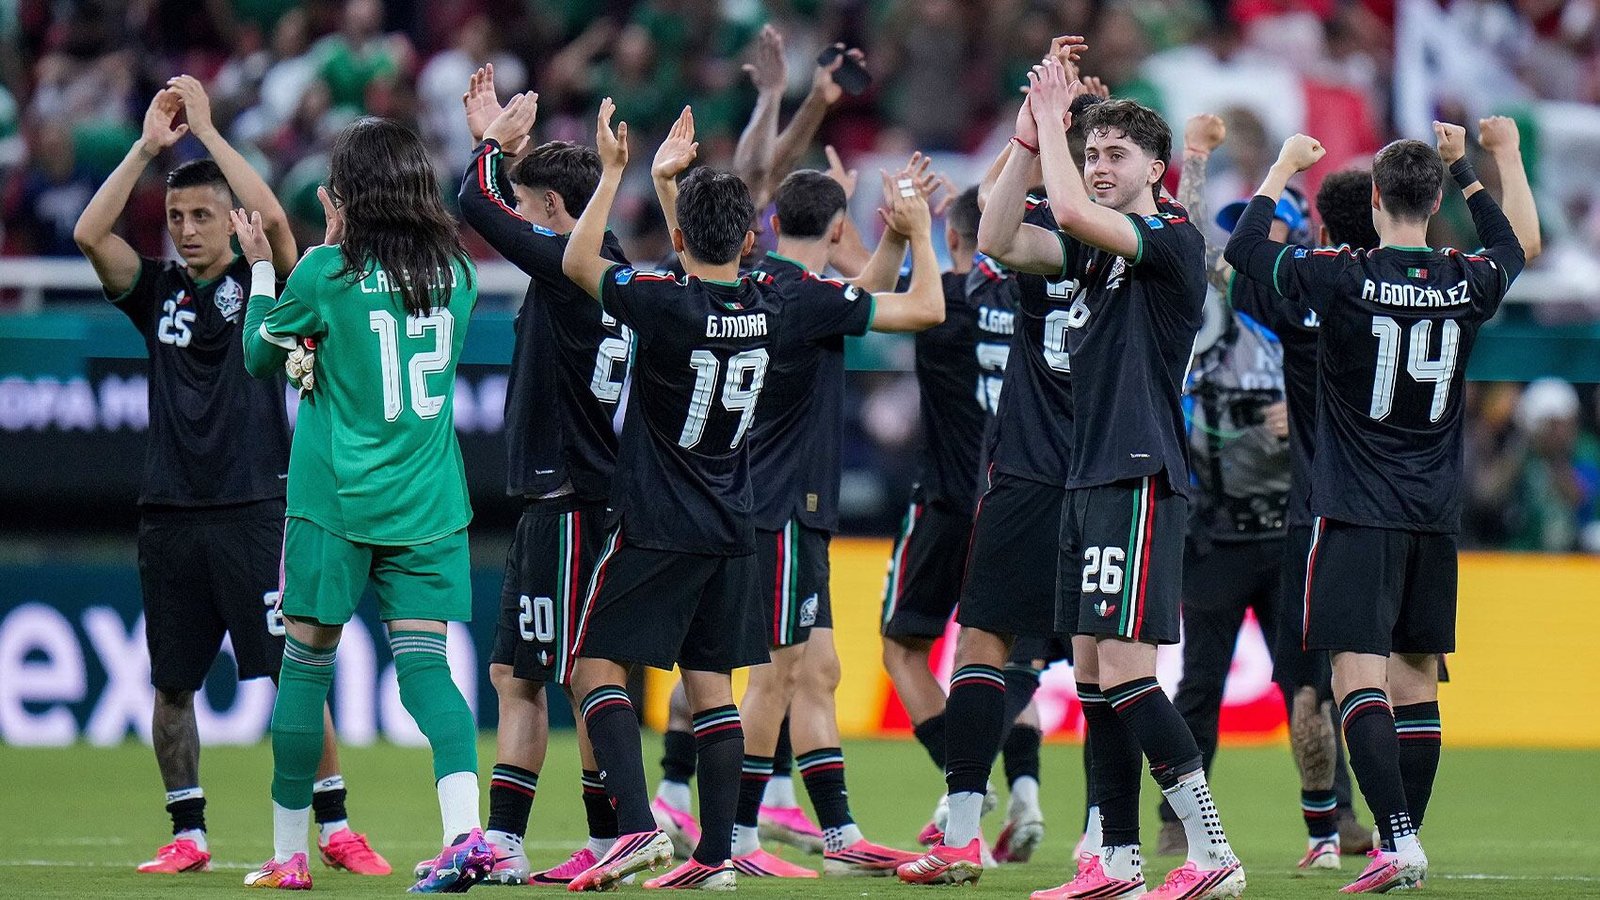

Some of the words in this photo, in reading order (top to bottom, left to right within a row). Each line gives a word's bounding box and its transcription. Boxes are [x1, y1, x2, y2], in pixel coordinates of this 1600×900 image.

[1362, 279, 1470, 308] A.GONZÁLEZ
[158, 300, 196, 348] 25
[706, 313, 768, 338] G.MORA
[369, 306, 455, 423] 12
[1370, 316, 1461, 423] 14
[678, 348, 770, 450] 19
[1081, 546, 1126, 594] 26
[519, 595, 555, 643] 20
